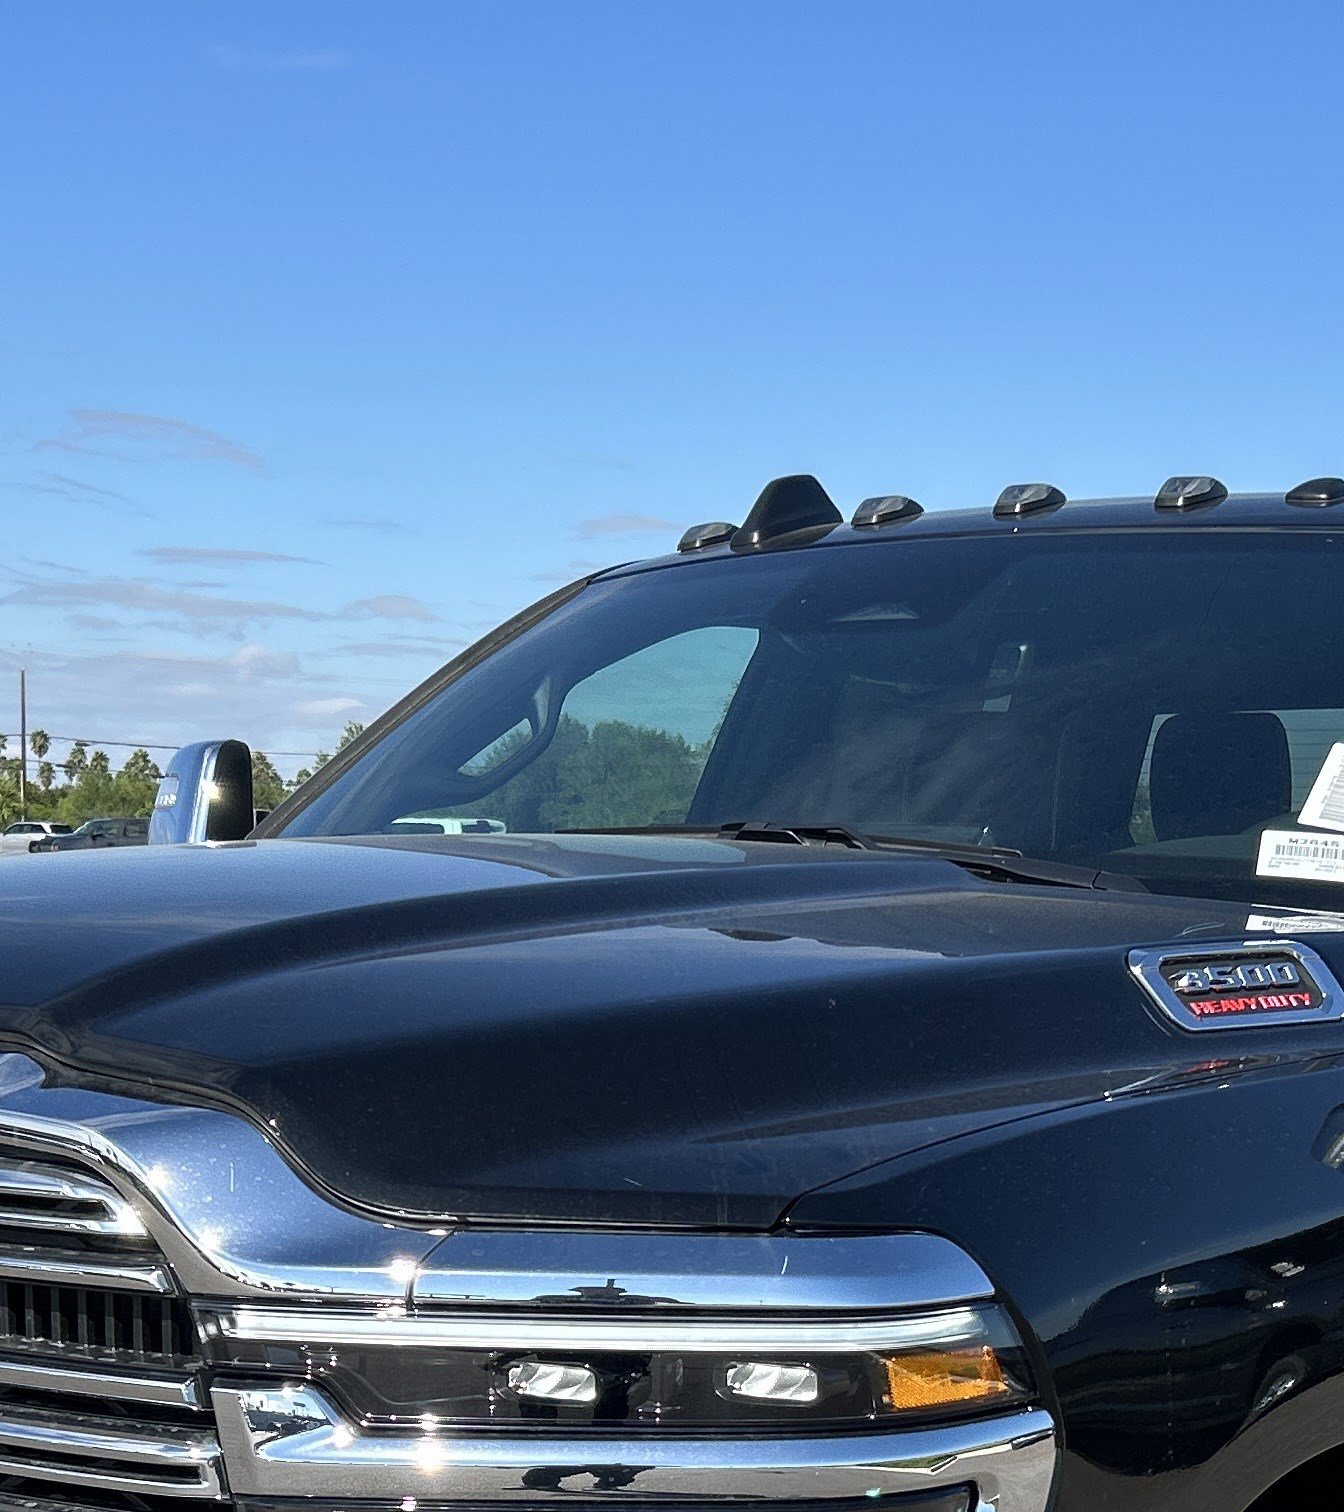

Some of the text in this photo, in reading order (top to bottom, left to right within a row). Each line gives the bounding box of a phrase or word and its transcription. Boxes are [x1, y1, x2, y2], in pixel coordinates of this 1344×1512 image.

[1168, 961, 1300, 995] 3500
[1188, 993, 1312, 1016] HEAVY DUTY
